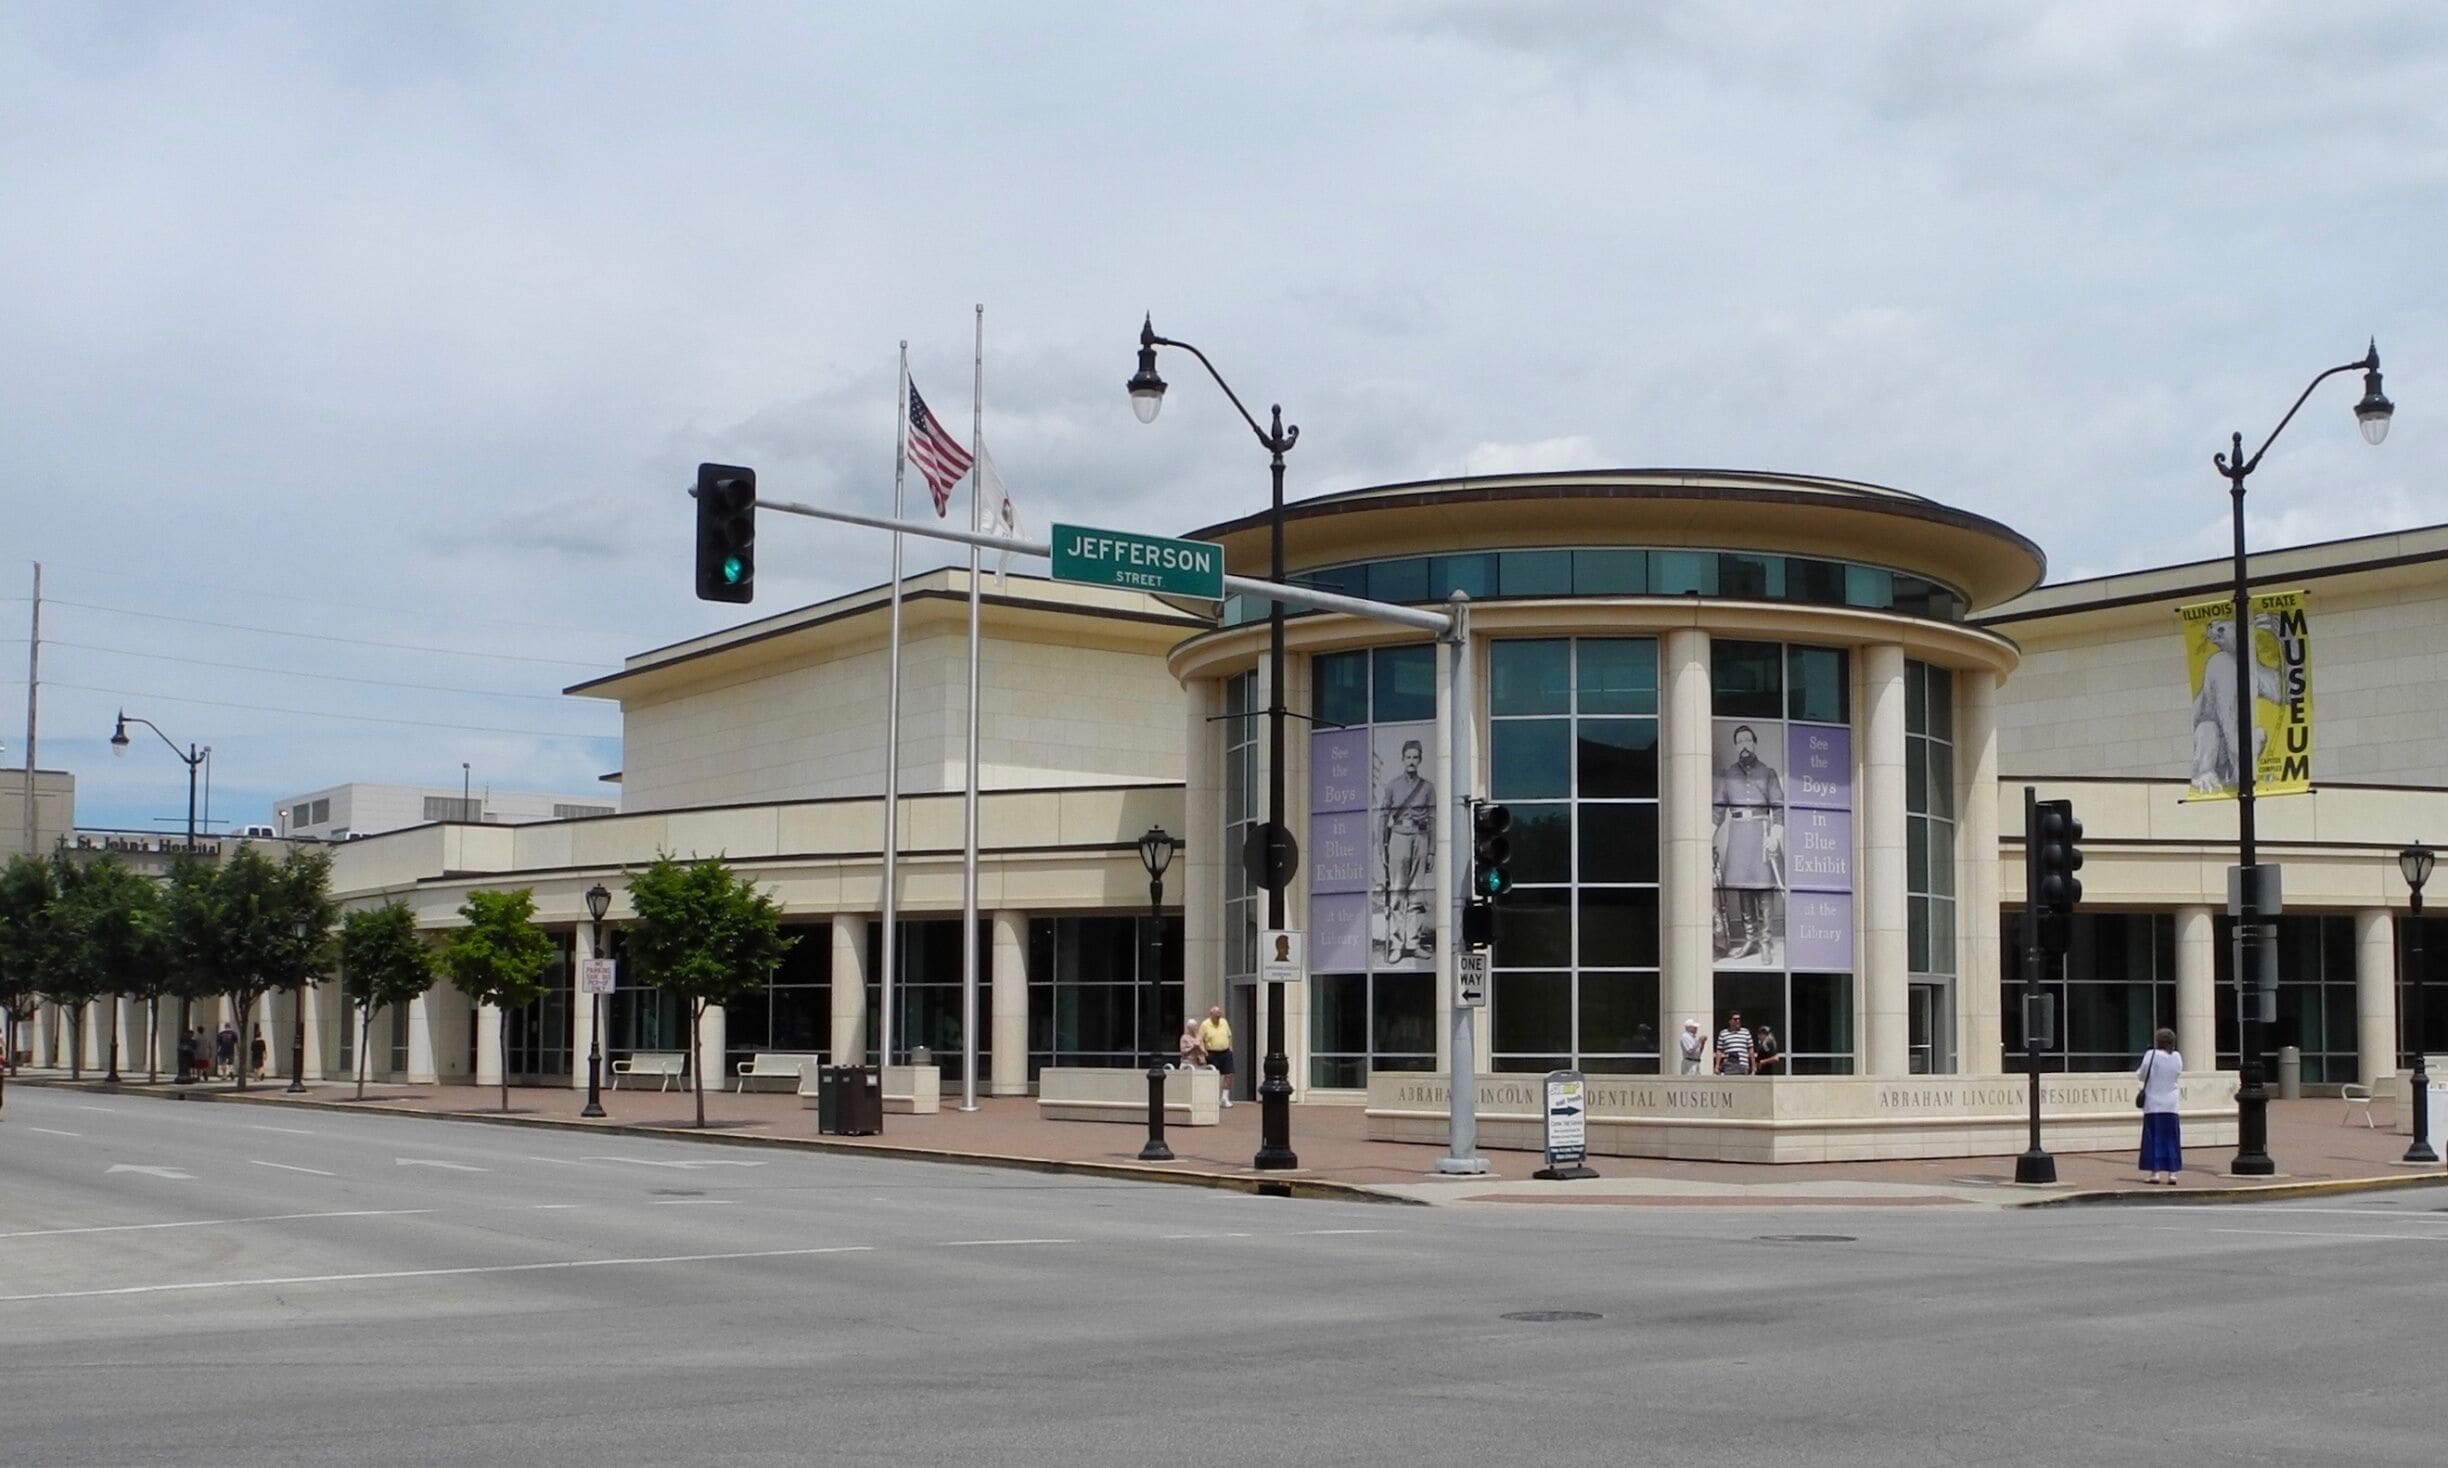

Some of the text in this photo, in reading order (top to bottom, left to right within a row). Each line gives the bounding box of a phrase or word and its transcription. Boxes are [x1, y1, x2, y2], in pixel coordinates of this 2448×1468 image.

[1067, 535, 1211, 573] JEFFERSON
[1116, 570, 1163, 588] STREET
[2183, 594, 2296, 621] ILLINOIS STATE
[2279, 608, 2310, 782] MUSEUM
[1809, 736, 1829, 750] See
[1331, 746, 1349, 759] See
[1811, 755, 1828, 768] the
[1332, 764, 1348, 777] the
[1325, 785, 1356, 805] Boys
[1802, 775, 1837, 797] Boys
[1333, 819, 1346, 834] in
[1812, 811, 1827, 826] in
[77, 834, 97, 849] St.
[105, 836, 149, 852] John's
[1325, 841, 1354, 857] Blue
[1805, 833, 1836, 850] Blue
[1317, 863, 1364, 881] Exhibit
[1793, 854, 1847, 875] Exhibit
[1819, 902, 1837, 916] the
[1800, 924, 1842, 943] Library
[1460, 957, 1482, 970] ONE
[1460, 973, 1482, 986] WAY
[1398, 1086, 1452, 1103] ABRAHA
[1475, 1087, 1534, 1104] INCOLN
[1666, 1090, 1733, 1109] MUSEUM
[1880, 1090, 1954, 1107] ABRAHAM
[1962, 1089, 2024, 1106] LINCOLN
[2040, 1087, 2130, 1105] RESIDENTIAL
